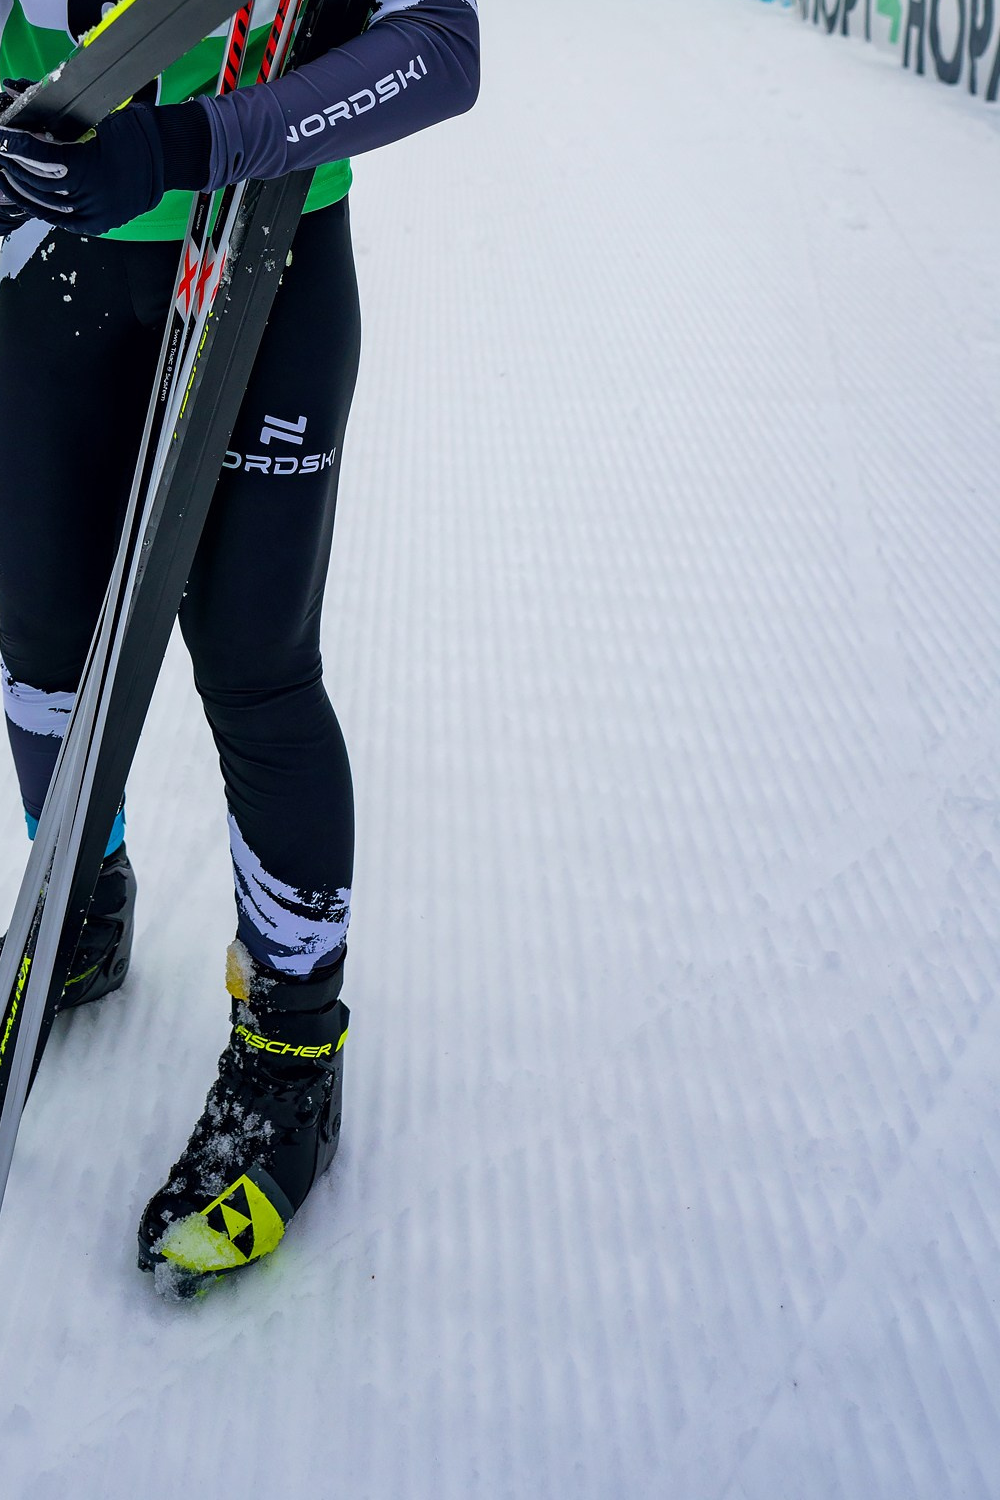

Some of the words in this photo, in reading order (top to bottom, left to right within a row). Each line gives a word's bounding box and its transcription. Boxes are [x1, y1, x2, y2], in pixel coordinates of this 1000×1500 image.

[171, 328, 181, 346] Swix
[167, 347, 177, 366] Triac
[160, 372, 172, 402] System
[234, 1025, 333, 1058] FISCHER
